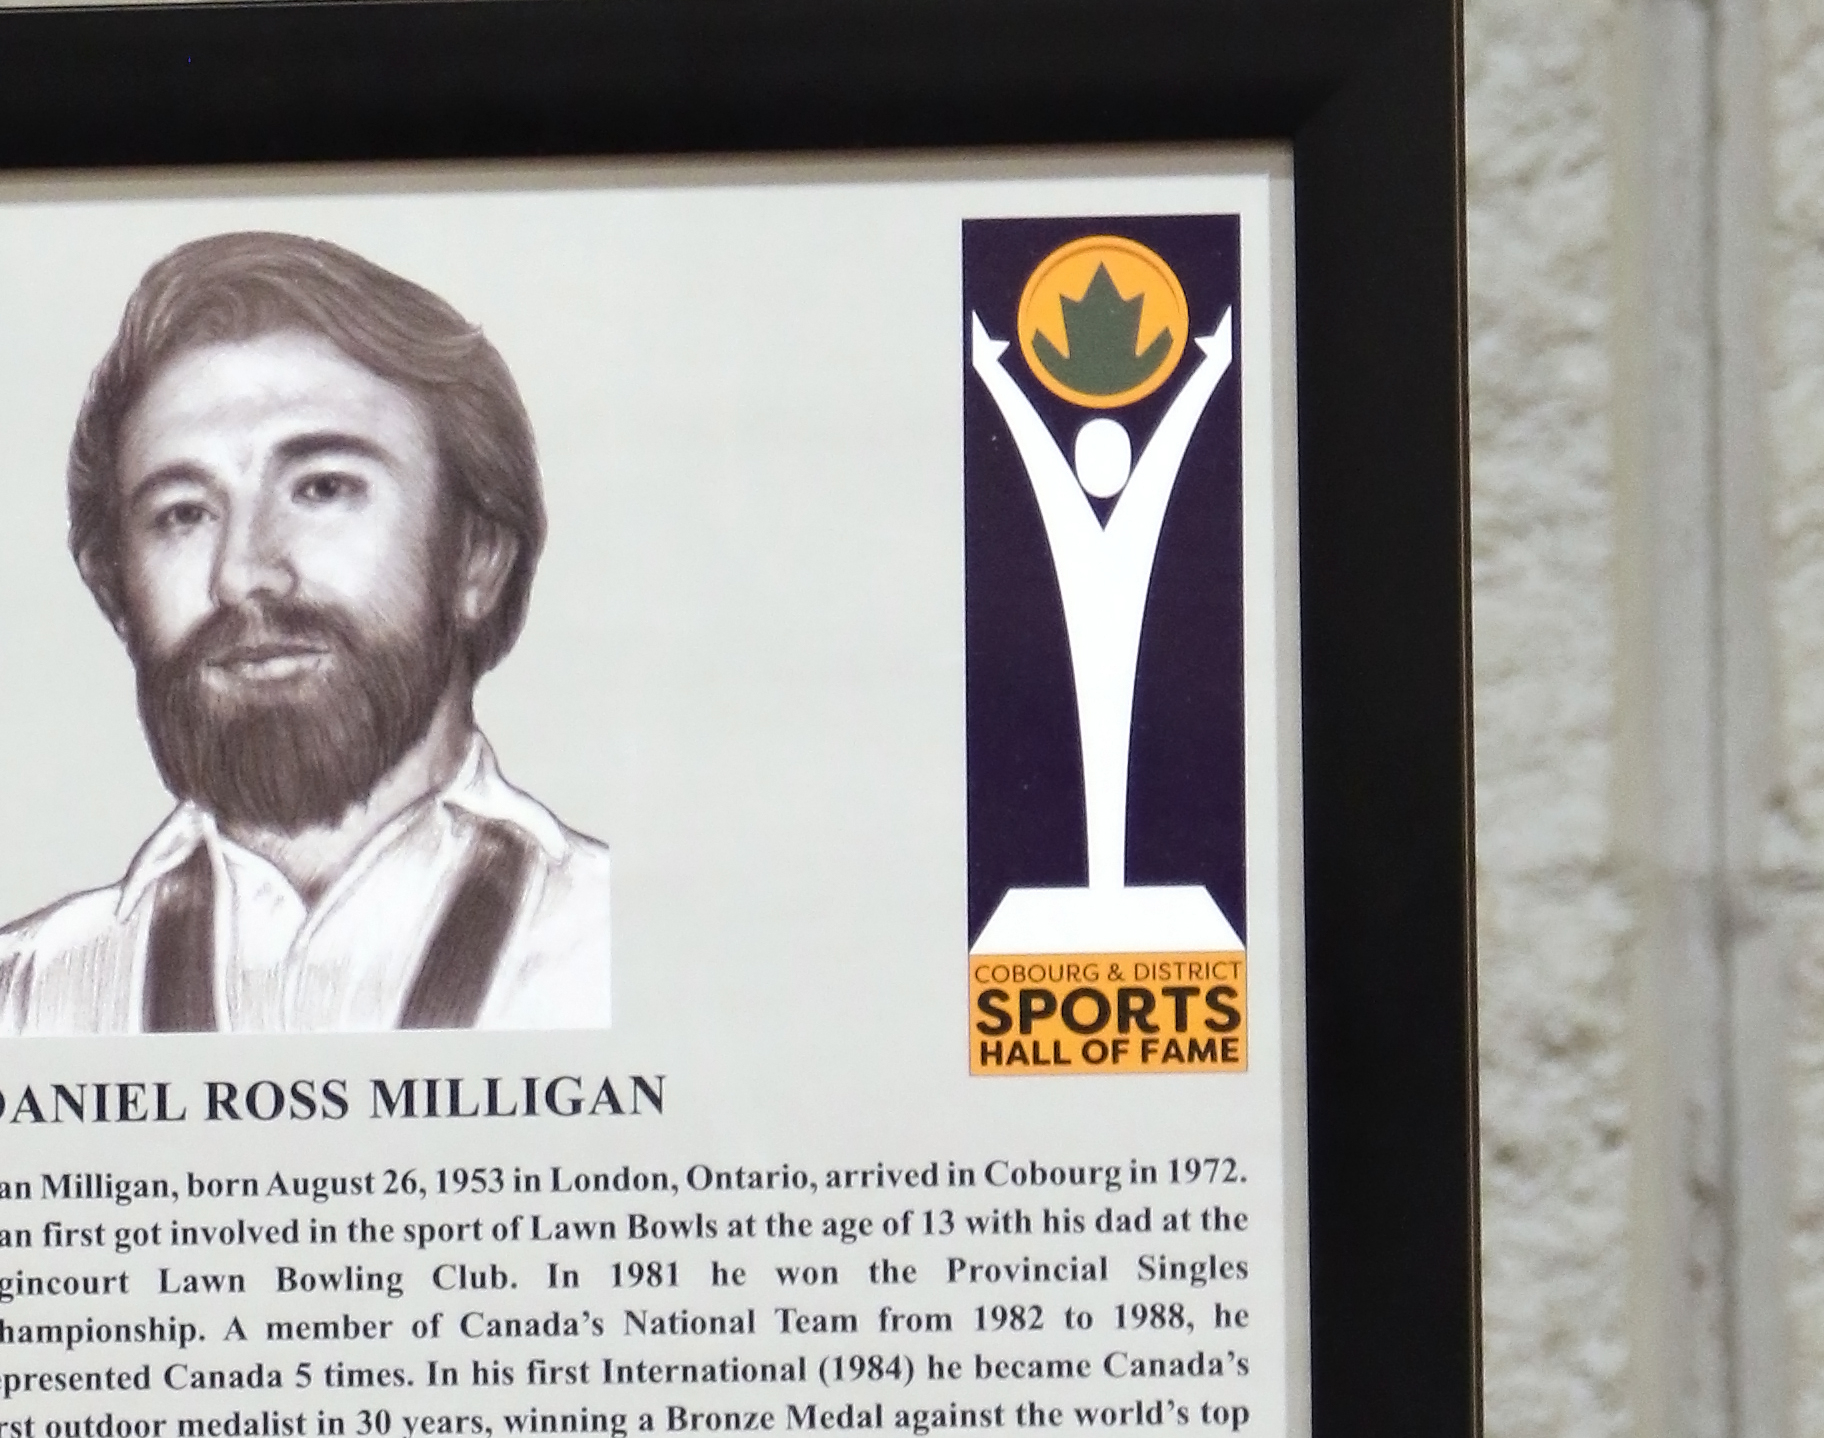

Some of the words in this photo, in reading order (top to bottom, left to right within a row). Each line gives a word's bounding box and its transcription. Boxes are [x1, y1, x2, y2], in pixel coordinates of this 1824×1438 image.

[974, 962, 1100, 984] COBOURG
[1107, 962, 1125, 981] &
[1133, 960, 1243, 982] DISTRICT
[975, 985, 1243, 1036] SPORTS
[979, 1039, 1072, 1067] HALL
[1081, 1038, 1130, 1065] OF
[1140, 1036, 1240, 1065] FAME
[203, 1077, 350, 1122] ROSS
[368, 1074, 667, 1119] MILLIGAN
[41, 1172, 179, 1207] Milligan,
[186, 1171, 259, 1198] born
[265, 1170, 376, 1204] August
[383, 1168, 427, 1200] 26,
[436, 1166, 505, 1194] 1953
[513, 1166, 542, 1193] in
[550, 1165, 679, 1197] London,
[686, 1162, 818, 1194] Ontario,
[825, 1160, 940, 1189] arrived
[947, 1160, 976, 1187] in
[984, 1159, 1123, 1193] Cobourg
[1129, 1157, 1158, 1185] in
[1169, 1156, 1248, 1184] 1972.
[158, 1267, 246, 1294] Lawn
[275, 1264, 404, 1299] Bowling
[432, 1263, 518, 1291] Club.
[547, 1262, 580, 1289] In
[611, 1260, 678, 1288] 1981
[711, 1260, 747, 1287] he
[774, 1265, 839, 1286] won
[868, 1257, 918, 1285] the
[947, 1255, 1108, 1284] Provincial
[1137, 1253, 1249, 1288] Singles
[163, 1362, 283, 1391] Canada
[295, 1361, 312, 1389] 5
[323, 1360, 414, 1388] times.
[427, 1360, 459, 1387] In
[472, 1359, 515, 1386] his
[526, 1358, 590, 1386] first
[602, 1355, 807, 1385] International
[818, 1353, 915, 1388] (1984)
[927, 1353, 963, 1380] he
[974, 1353, 1092, 1380] became
